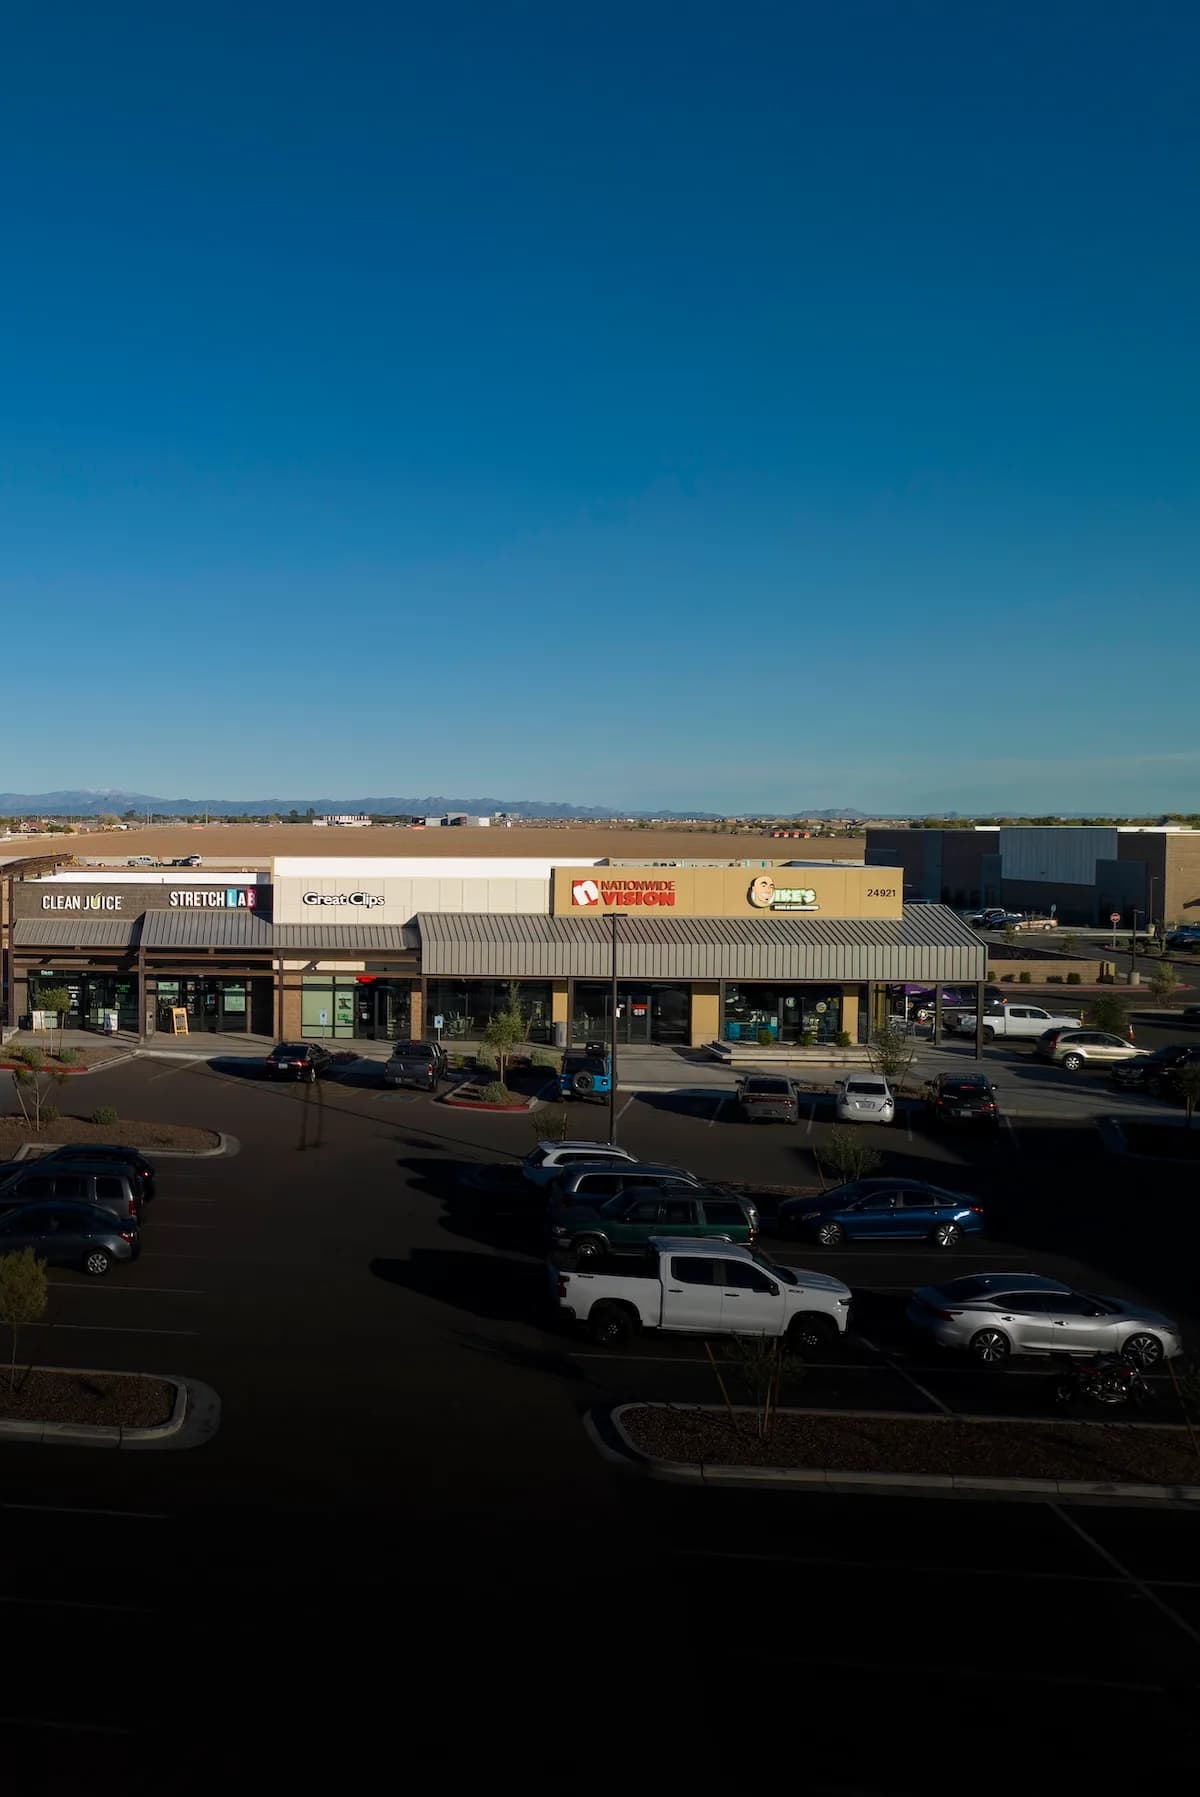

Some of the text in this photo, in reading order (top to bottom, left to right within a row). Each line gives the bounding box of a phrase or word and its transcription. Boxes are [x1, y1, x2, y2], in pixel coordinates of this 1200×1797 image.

[601, 881, 675, 891] NATIONWIDE
[867, 889, 896, 897] 24921
[42, 893, 122, 910] CLEAN JUICE
[303, 892, 385, 908] Great Clips
[601, 892, 675, 906] VISION
